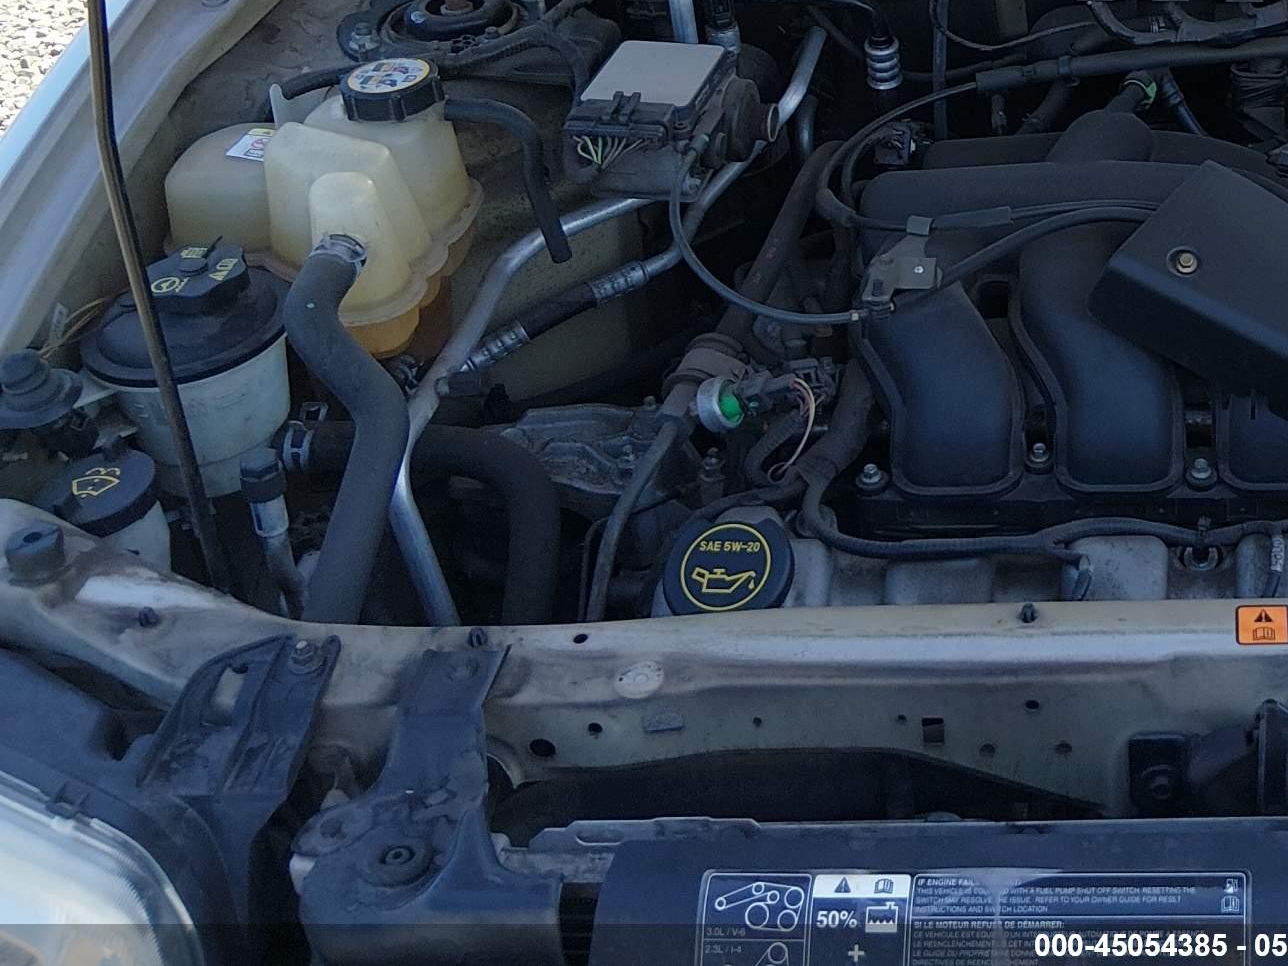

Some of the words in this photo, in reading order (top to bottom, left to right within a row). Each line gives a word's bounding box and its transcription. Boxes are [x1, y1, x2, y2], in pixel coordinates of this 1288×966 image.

[700, 541, 722, 552] SAE
[723, 541, 760, 552] 5W-20
[816, 910, 858, 928] 50%
[914, 920, 922, 928] SI
[924, 920, 934, 928] LE
[936, 920, 970, 928] MOTEUR
[1004, 920, 1016, 928] DE
[706, 928, 724, 936] 3.0L
[733, 928, 746, 936] V-6
[705, 944, 724, 954] 2.3L
